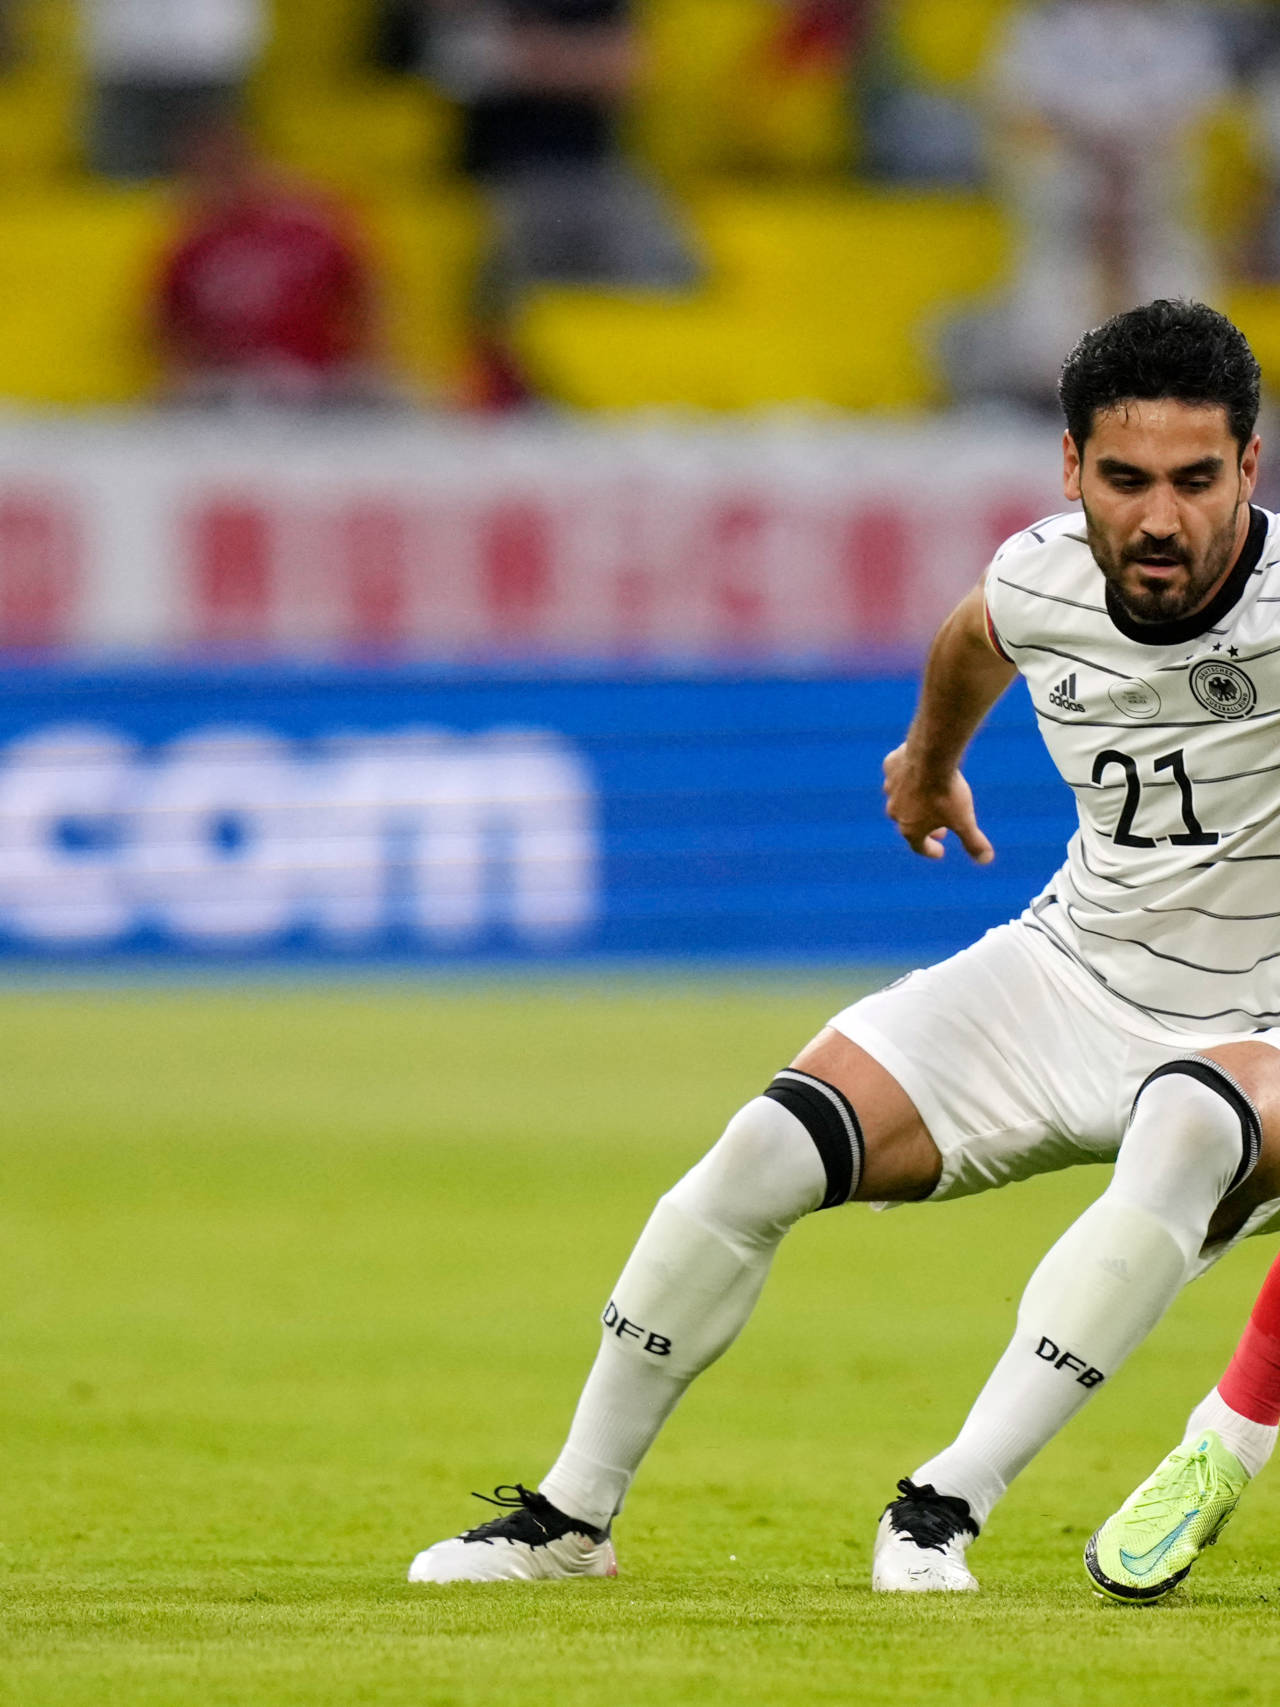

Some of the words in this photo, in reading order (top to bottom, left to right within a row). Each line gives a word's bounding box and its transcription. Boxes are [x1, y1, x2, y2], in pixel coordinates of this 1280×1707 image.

[1199, 667, 1234, 680] DEUTSCHER
[1048, 693, 1086, 713] adidas
[1091, 748, 1221, 849] 21
[0, 722, 594, 946] com
[602, 1300, 673, 1356] DFB
[1034, 1335, 1105, 1389] DFB
